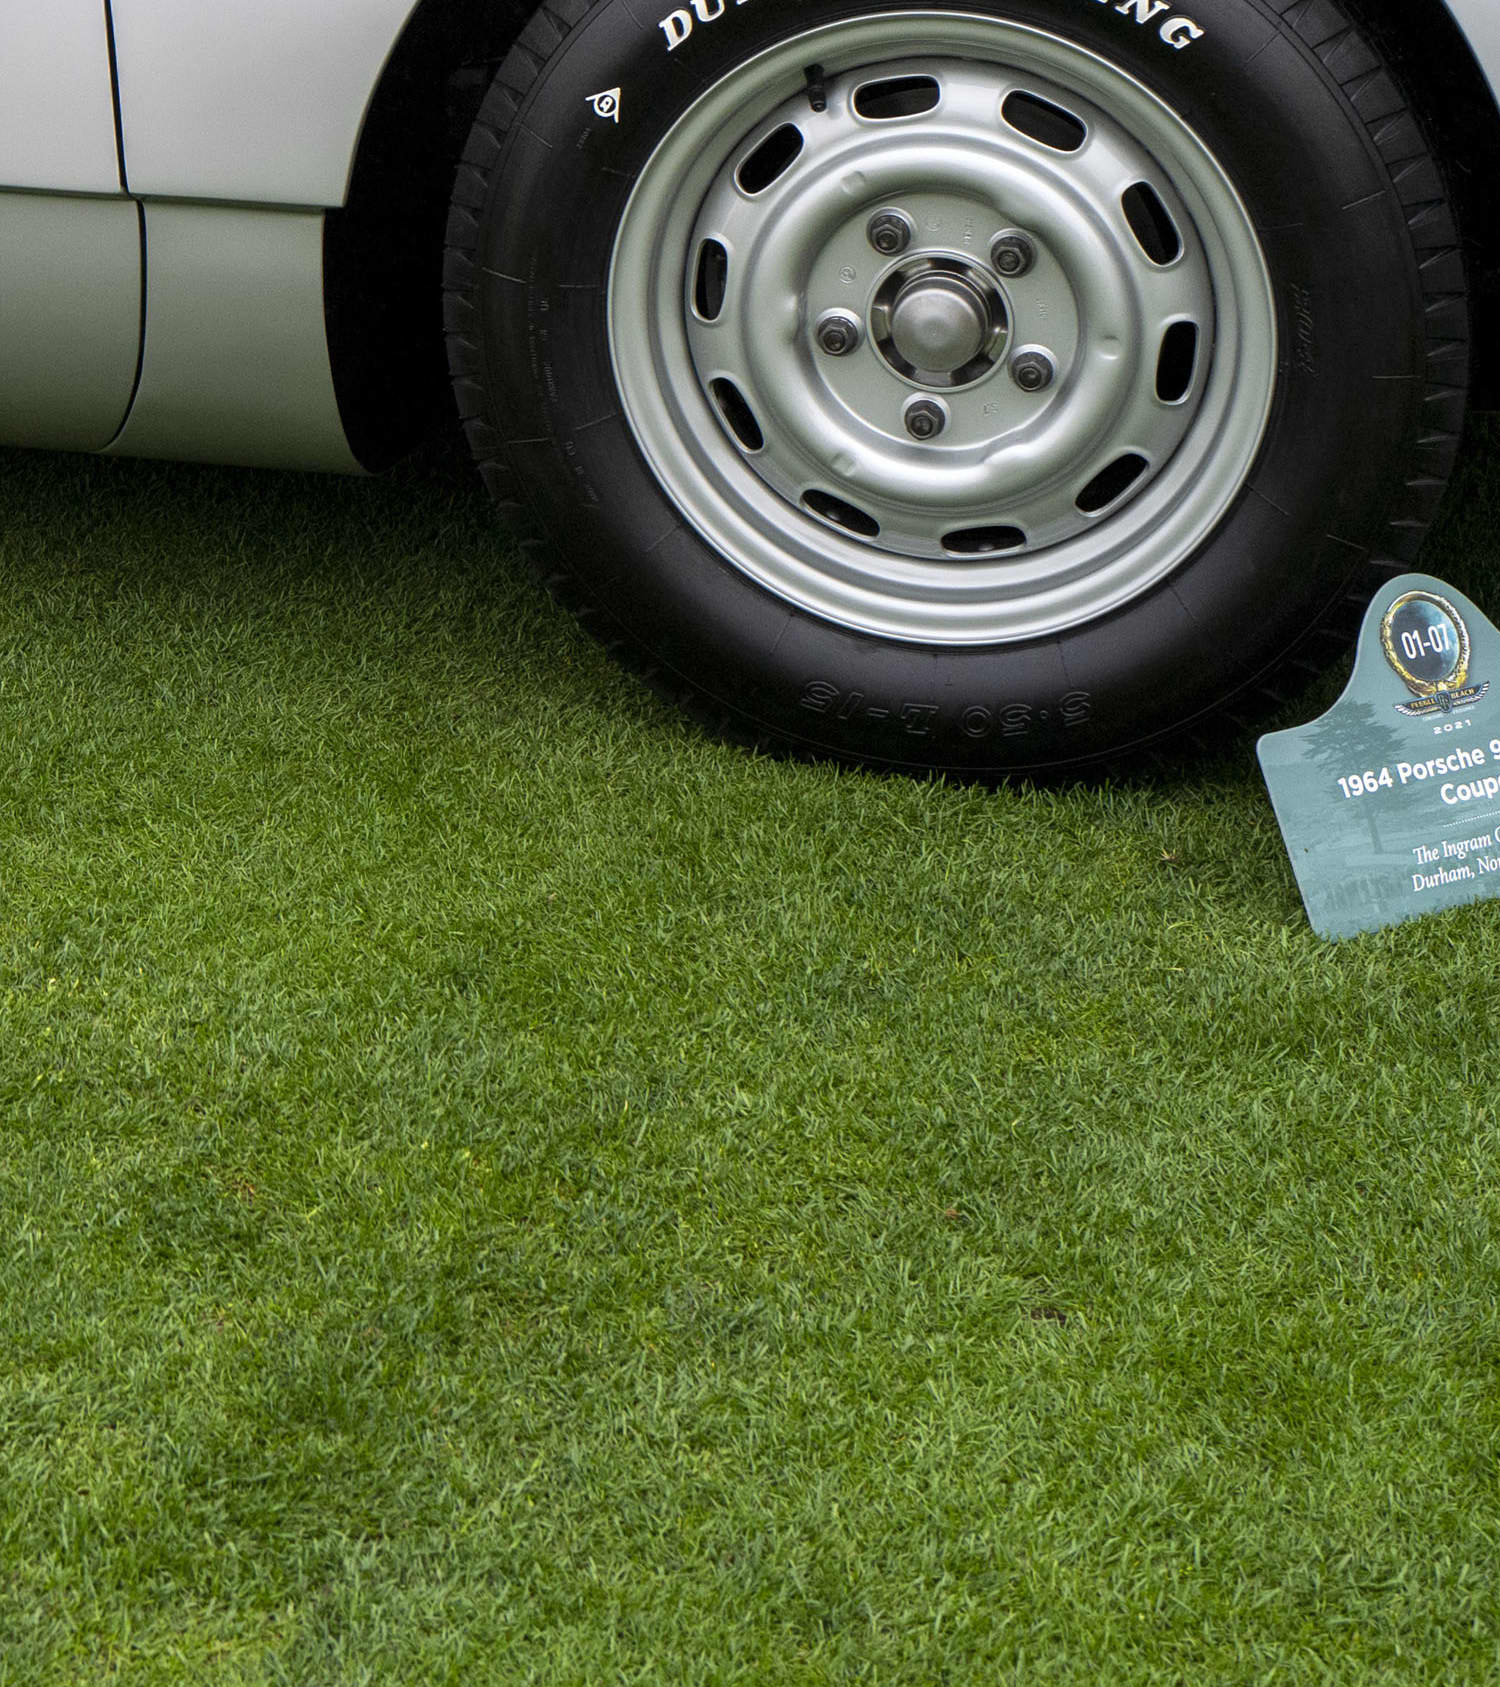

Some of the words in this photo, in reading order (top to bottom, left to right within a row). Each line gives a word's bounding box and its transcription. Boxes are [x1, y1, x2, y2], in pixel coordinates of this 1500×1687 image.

[1401, 624, 1450, 659] 01-07
[1433, 719, 1472, 735] 2021
[1337, 767, 1393, 799] 1964
[1396, 748, 1485, 784] Porsche
[1413, 845, 1439, 865] The
[1442, 832, 1492, 860] Ingram
[1412, 864, 1475, 892] Durham,
